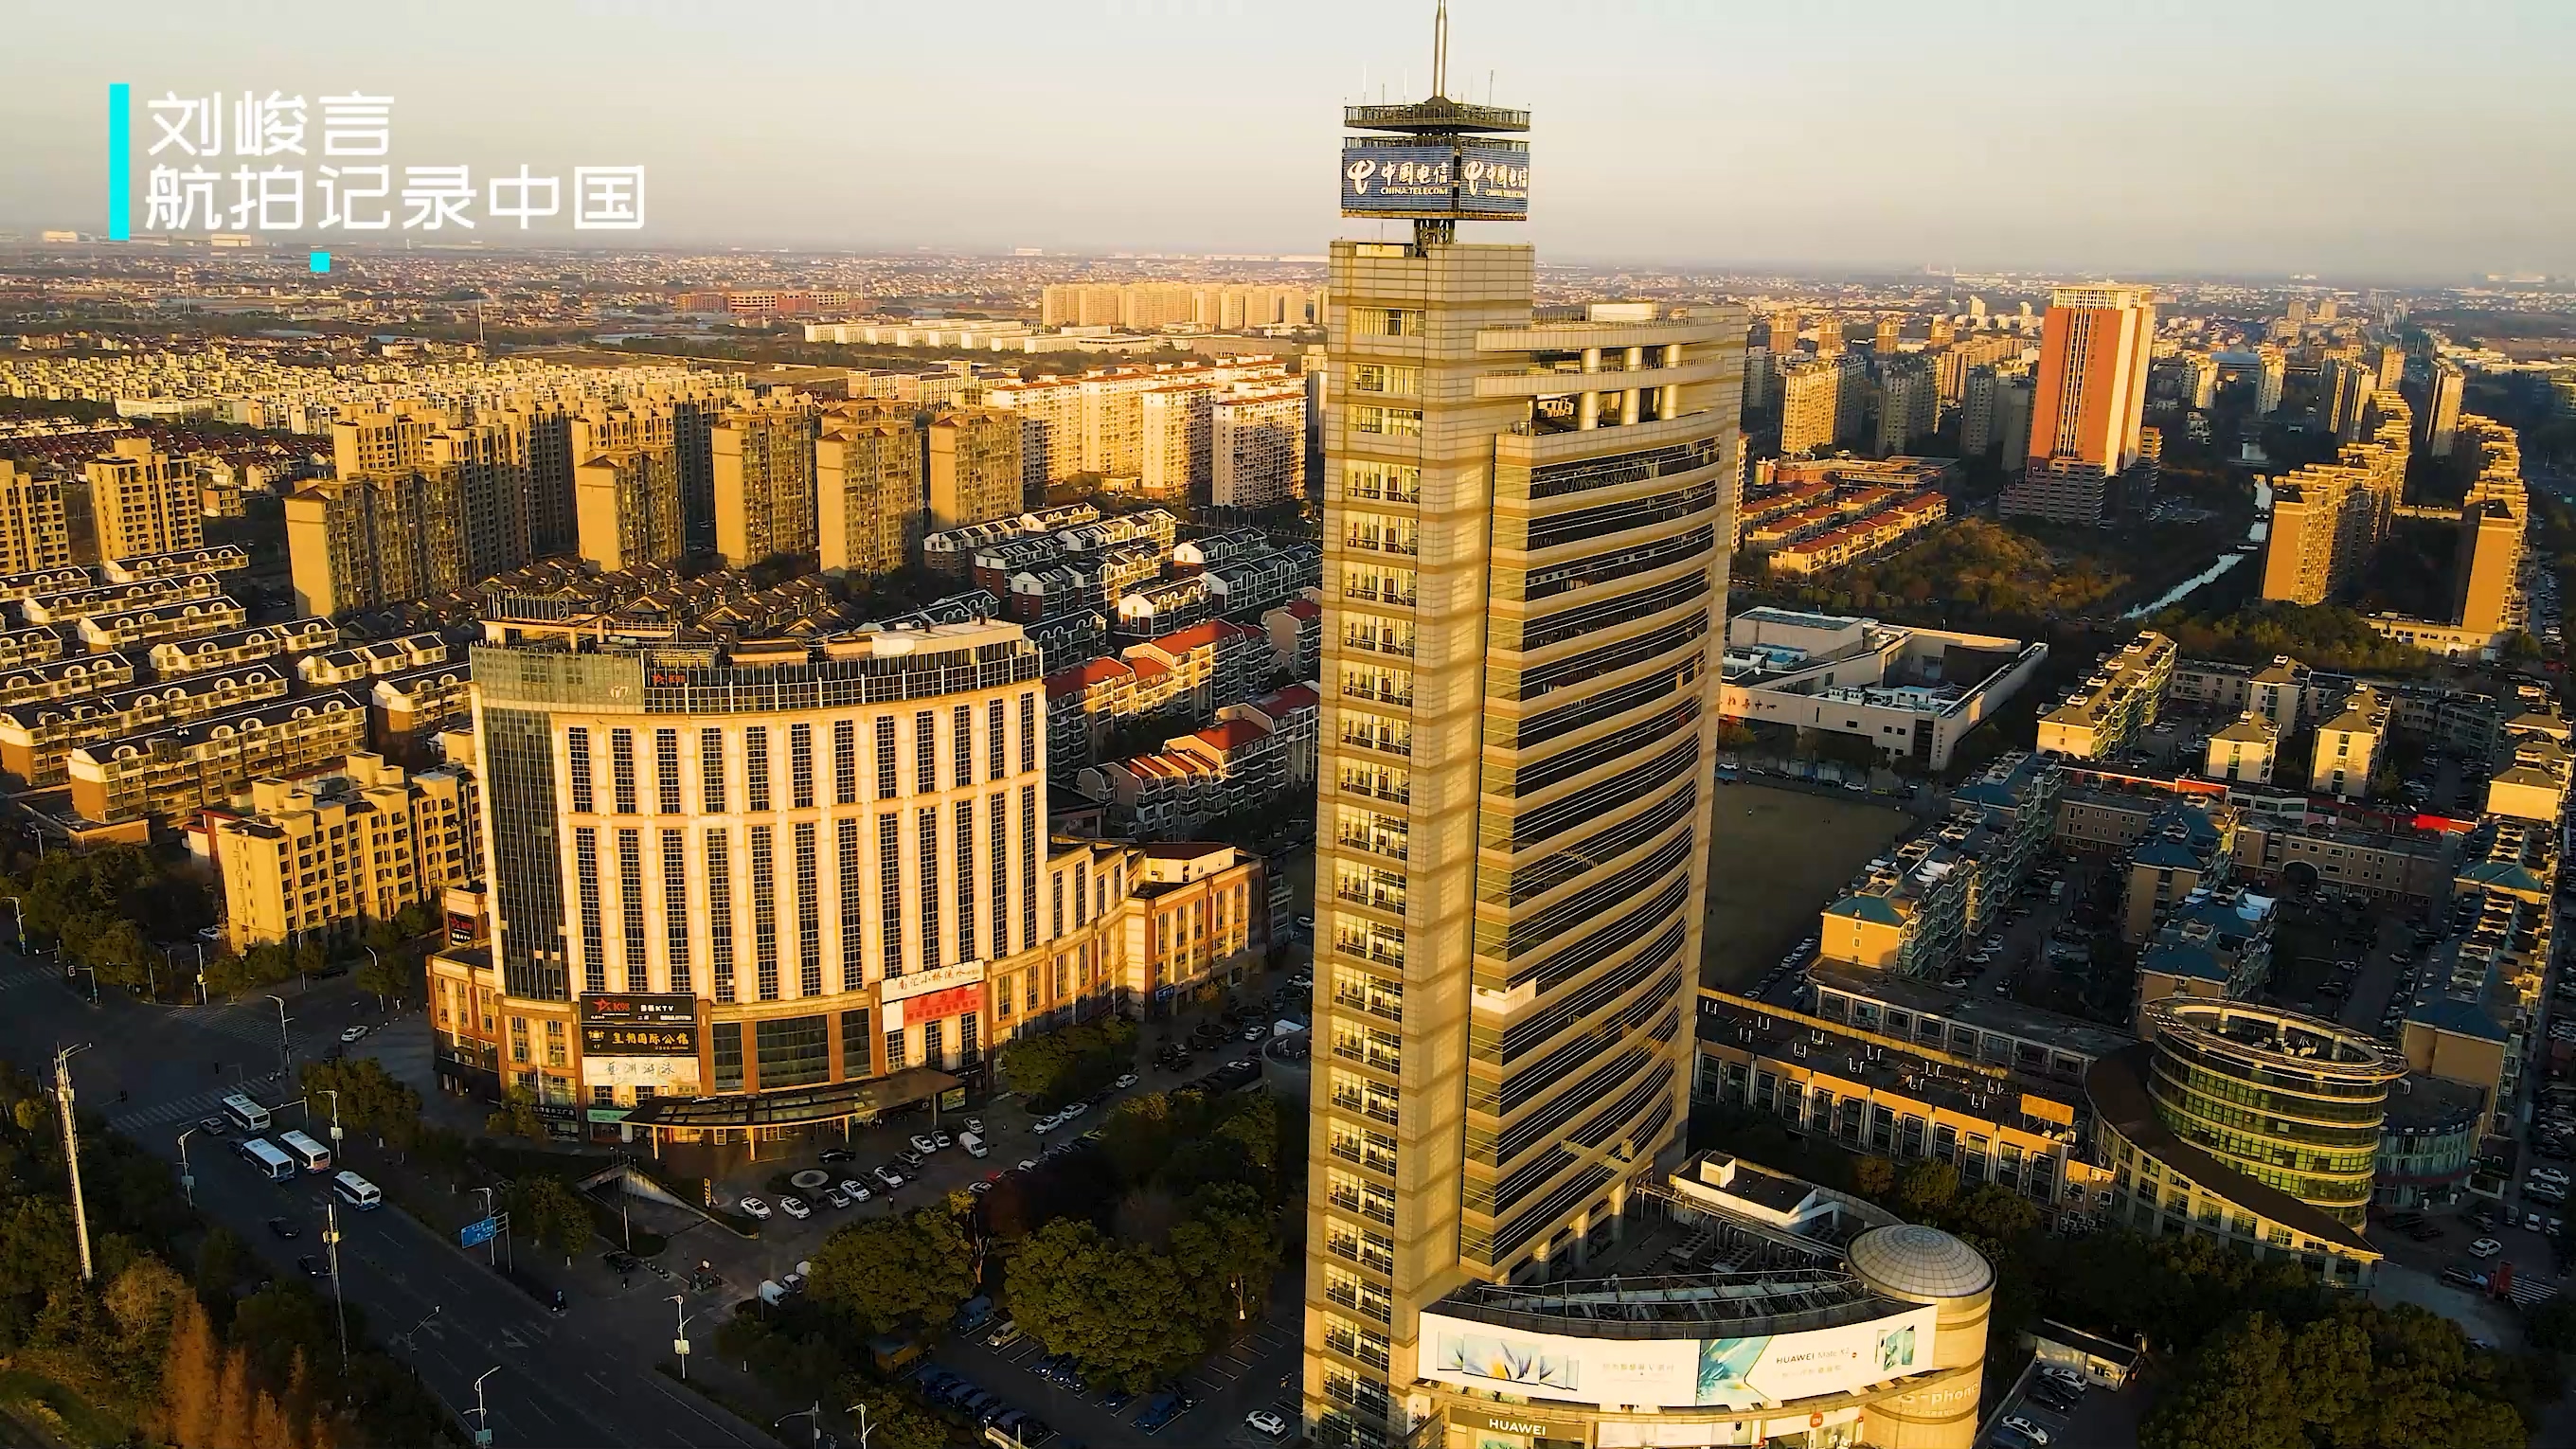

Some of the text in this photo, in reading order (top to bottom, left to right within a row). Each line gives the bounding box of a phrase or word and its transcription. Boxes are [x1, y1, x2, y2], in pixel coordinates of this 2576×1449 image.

[1381, 160, 1449, 187] 中国电信
[1486, 163, 1529, 188] 中国电信
[1380, 187, 1448, 195] CHINA TELECOM
[1776, 1352, 1815, 1364] HUAWEI
[1489, 1418, 1547, 1437] HUAWEI
